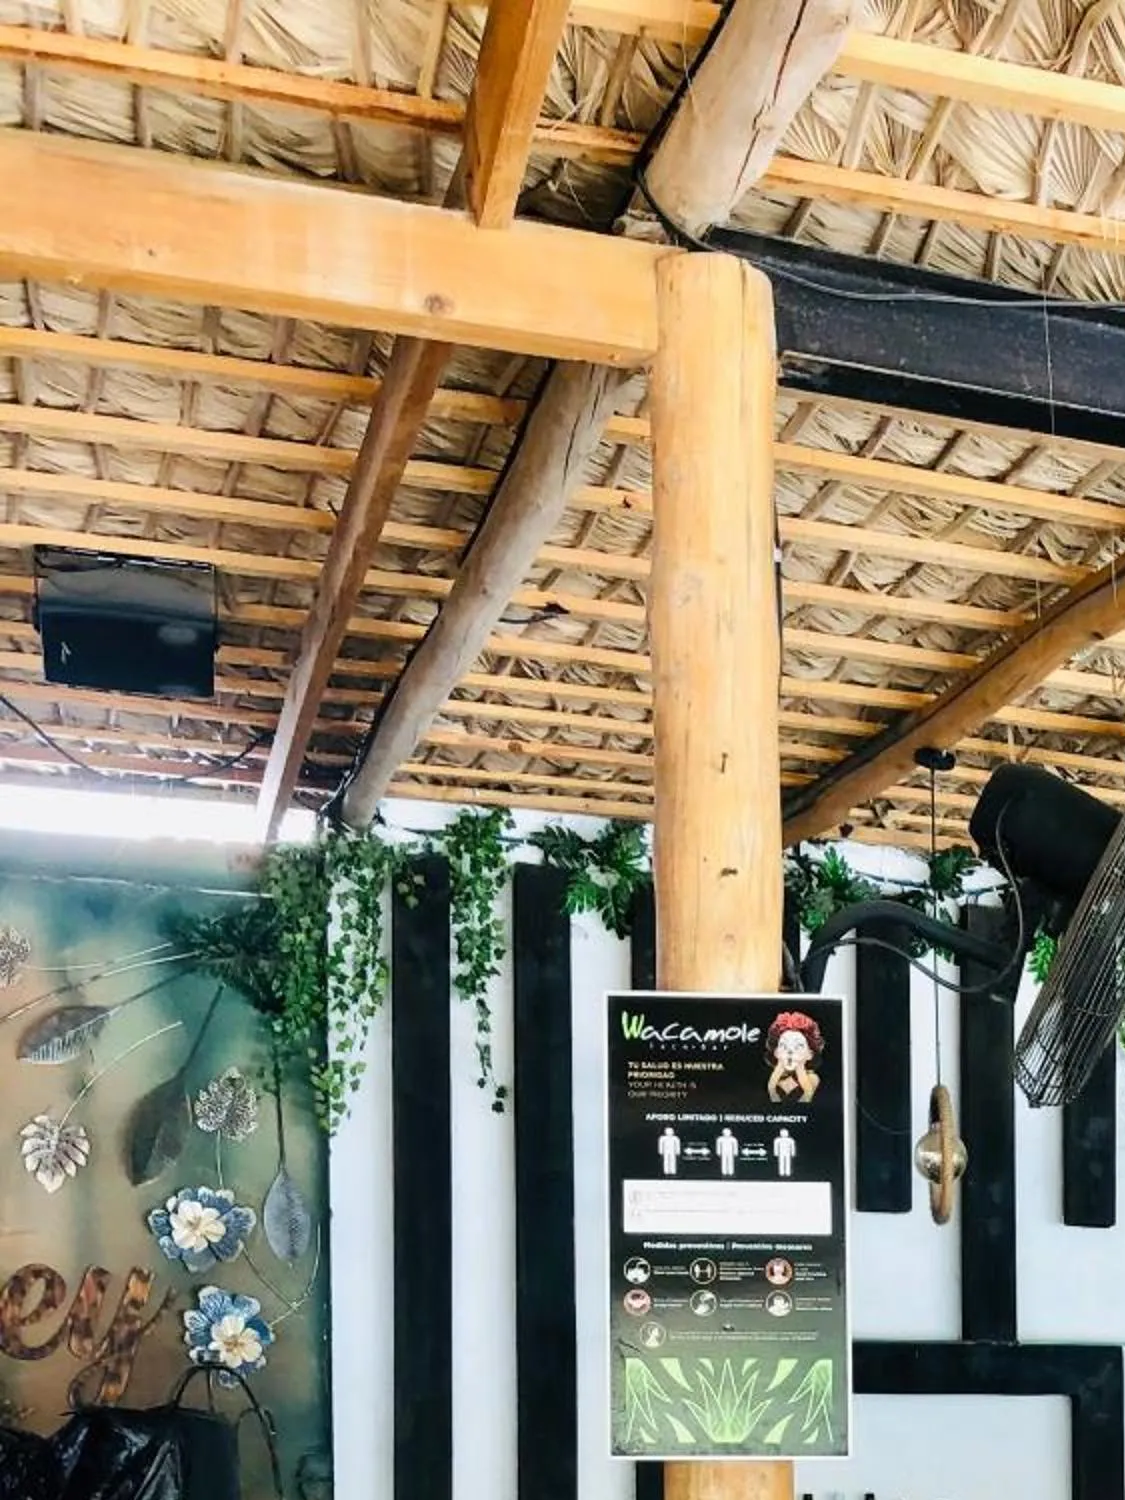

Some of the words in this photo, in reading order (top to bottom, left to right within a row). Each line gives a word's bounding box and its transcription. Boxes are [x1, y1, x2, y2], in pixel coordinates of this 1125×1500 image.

[621, 1010, 761, 1043] Wacamole
[641, 1061, 670, 1070] SALUD
[671, 1061, 683, 1070] ES
